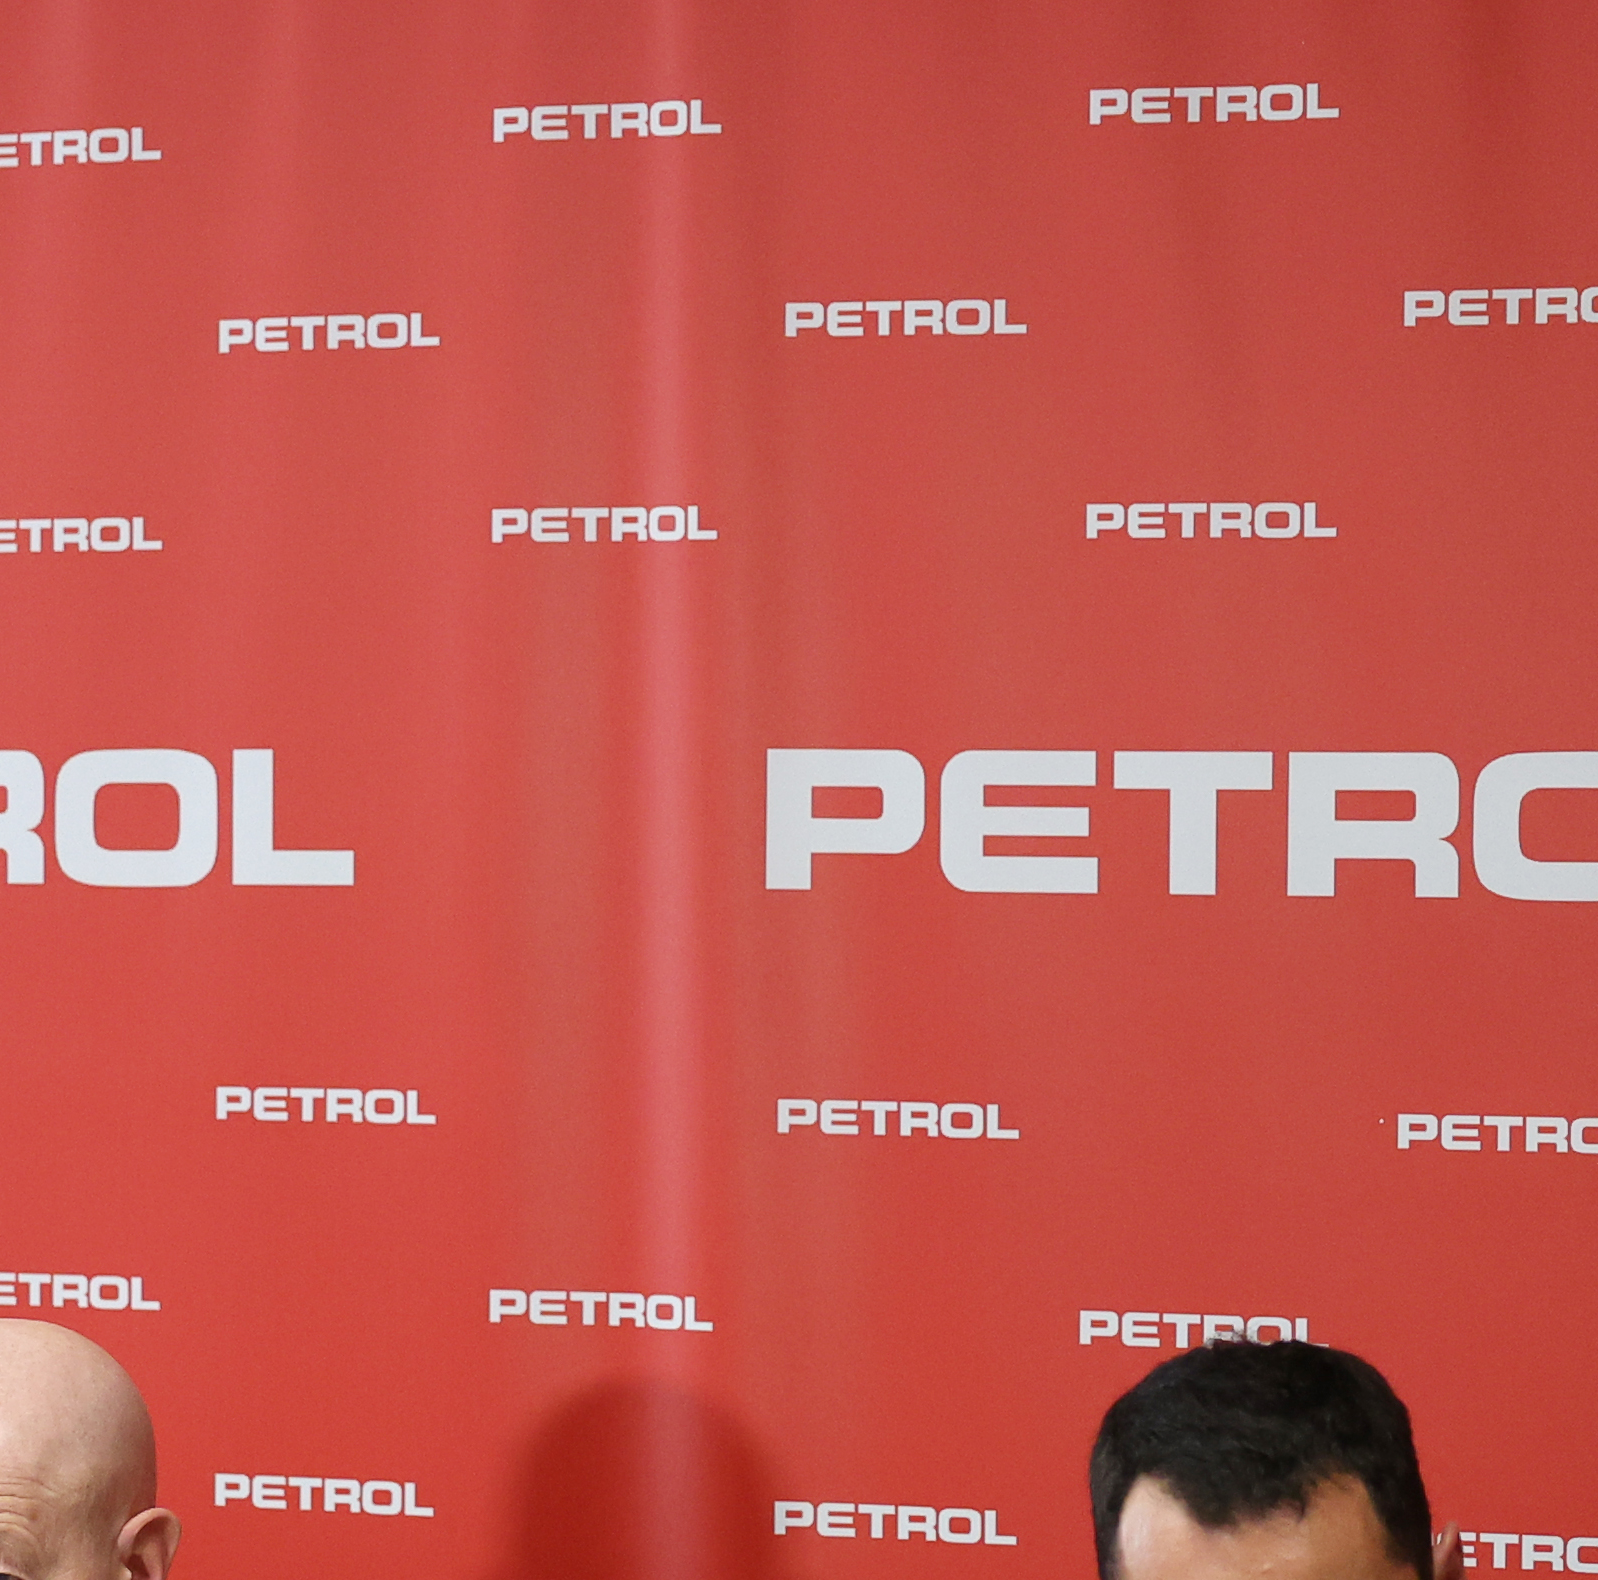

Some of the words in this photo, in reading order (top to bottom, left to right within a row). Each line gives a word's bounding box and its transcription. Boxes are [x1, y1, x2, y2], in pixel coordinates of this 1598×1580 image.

[493, 99, 722, 142] PETROL
[1090, 83, 1339, 125] PETROL
[219, 313, 440, 353] PETROL
[785, 299, 1027, 337] PETROL
[492, 505, 717, 543] PETROL
[1086, 502, 1337, 539] PETROL
[216, 1086, 436, 1124] PETROL
[777, 1099, 1019, 1139] PETROL
[489, 1289, 713, 1331] PETROL
[215, 1473, 434, 1516] PETROL
[775, 1501, 1017, 1545] PETROL
